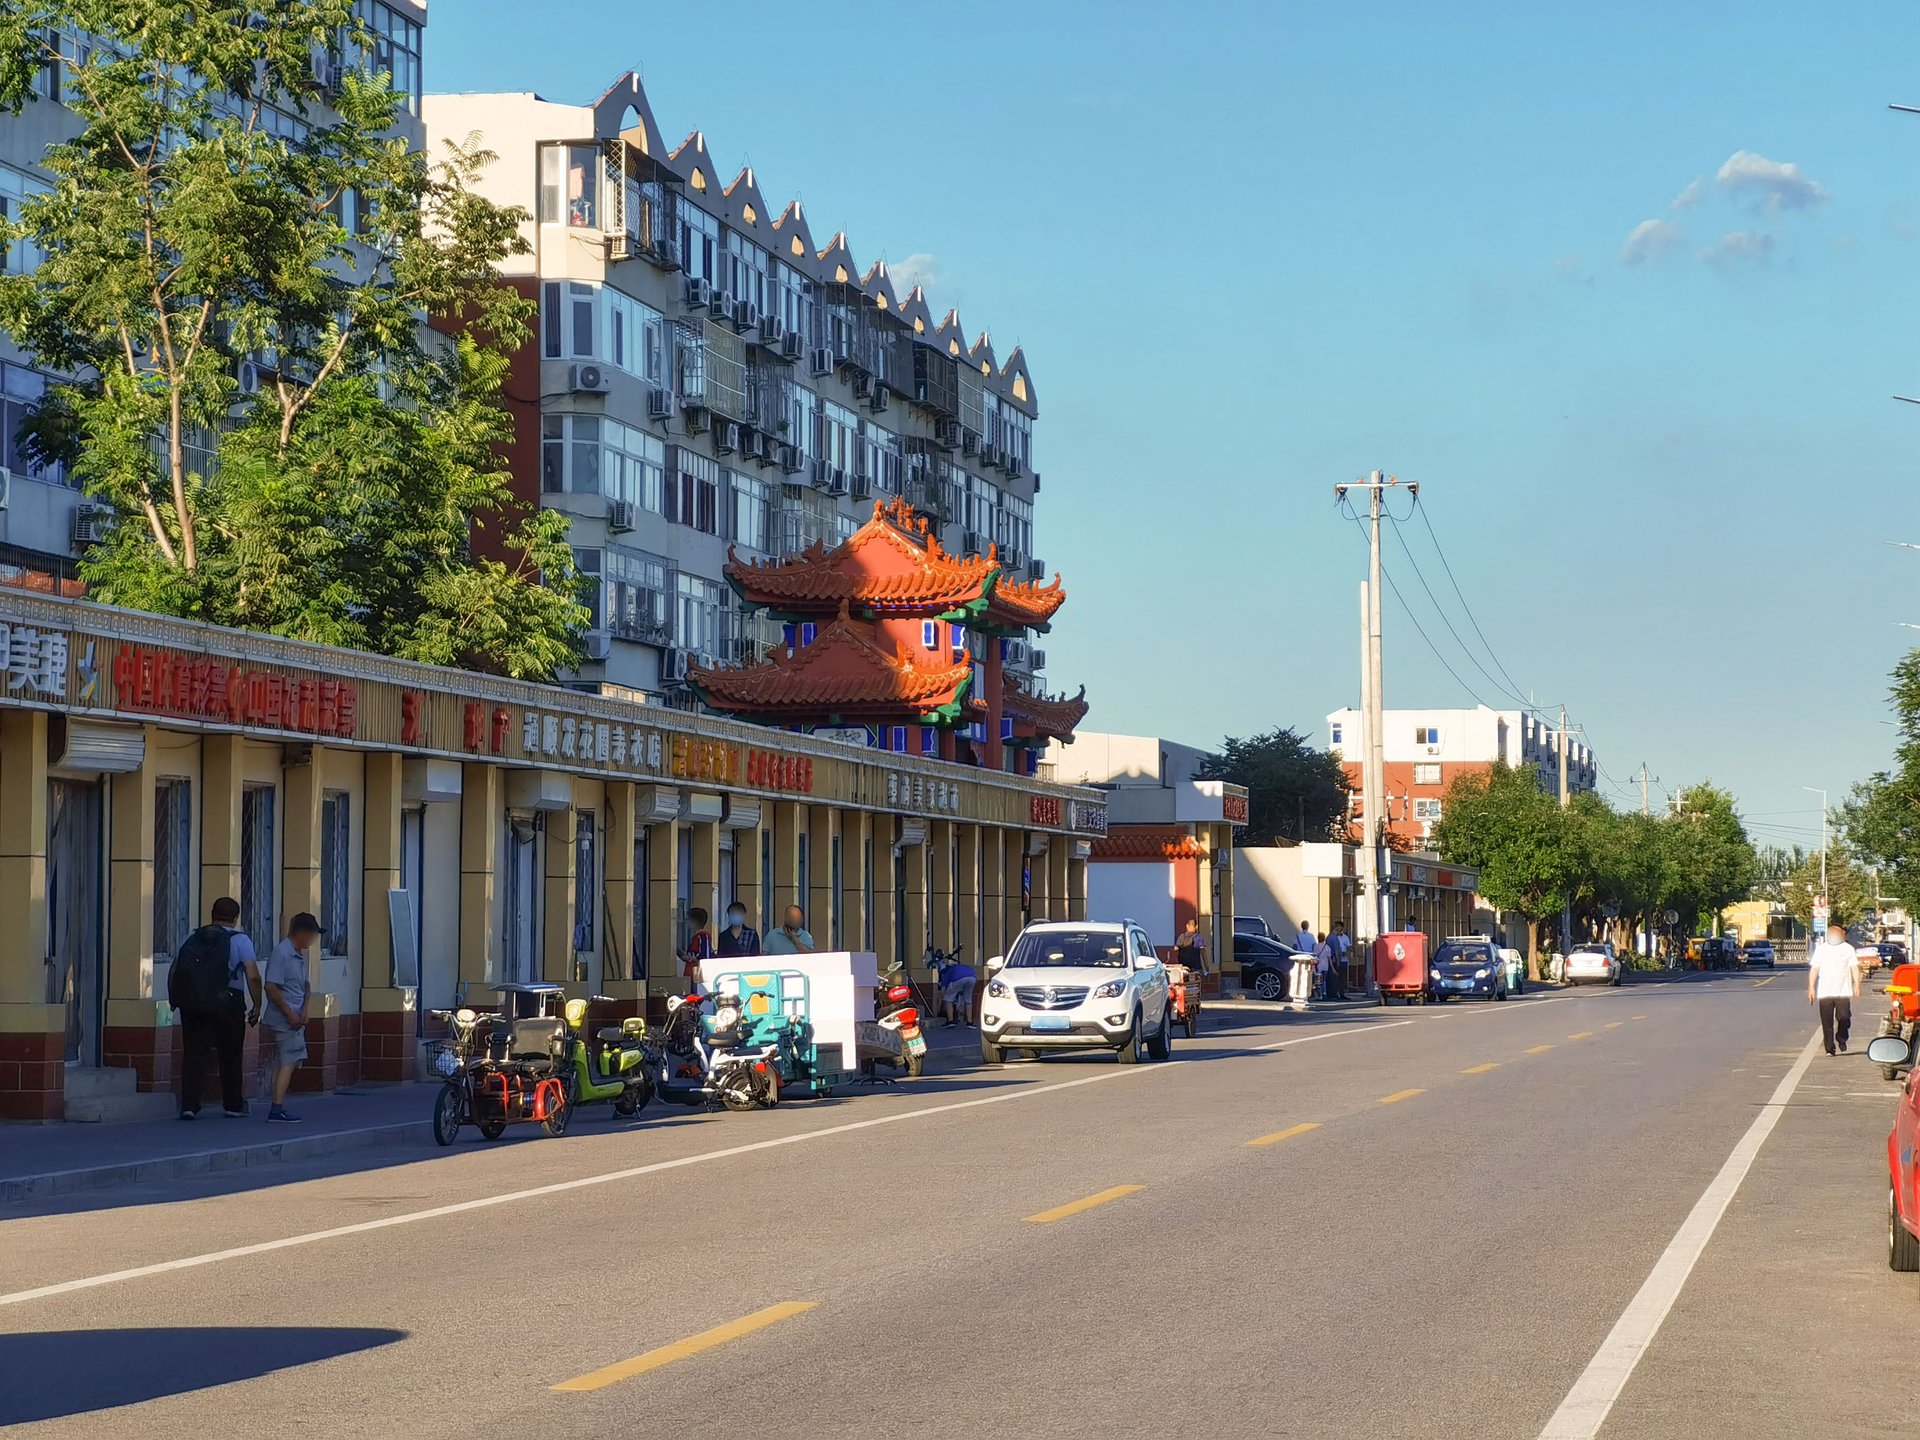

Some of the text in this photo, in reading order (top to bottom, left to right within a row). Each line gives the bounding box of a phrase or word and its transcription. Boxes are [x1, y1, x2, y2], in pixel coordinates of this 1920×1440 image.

[114, 644, 228, 713] 中国体育彩票
